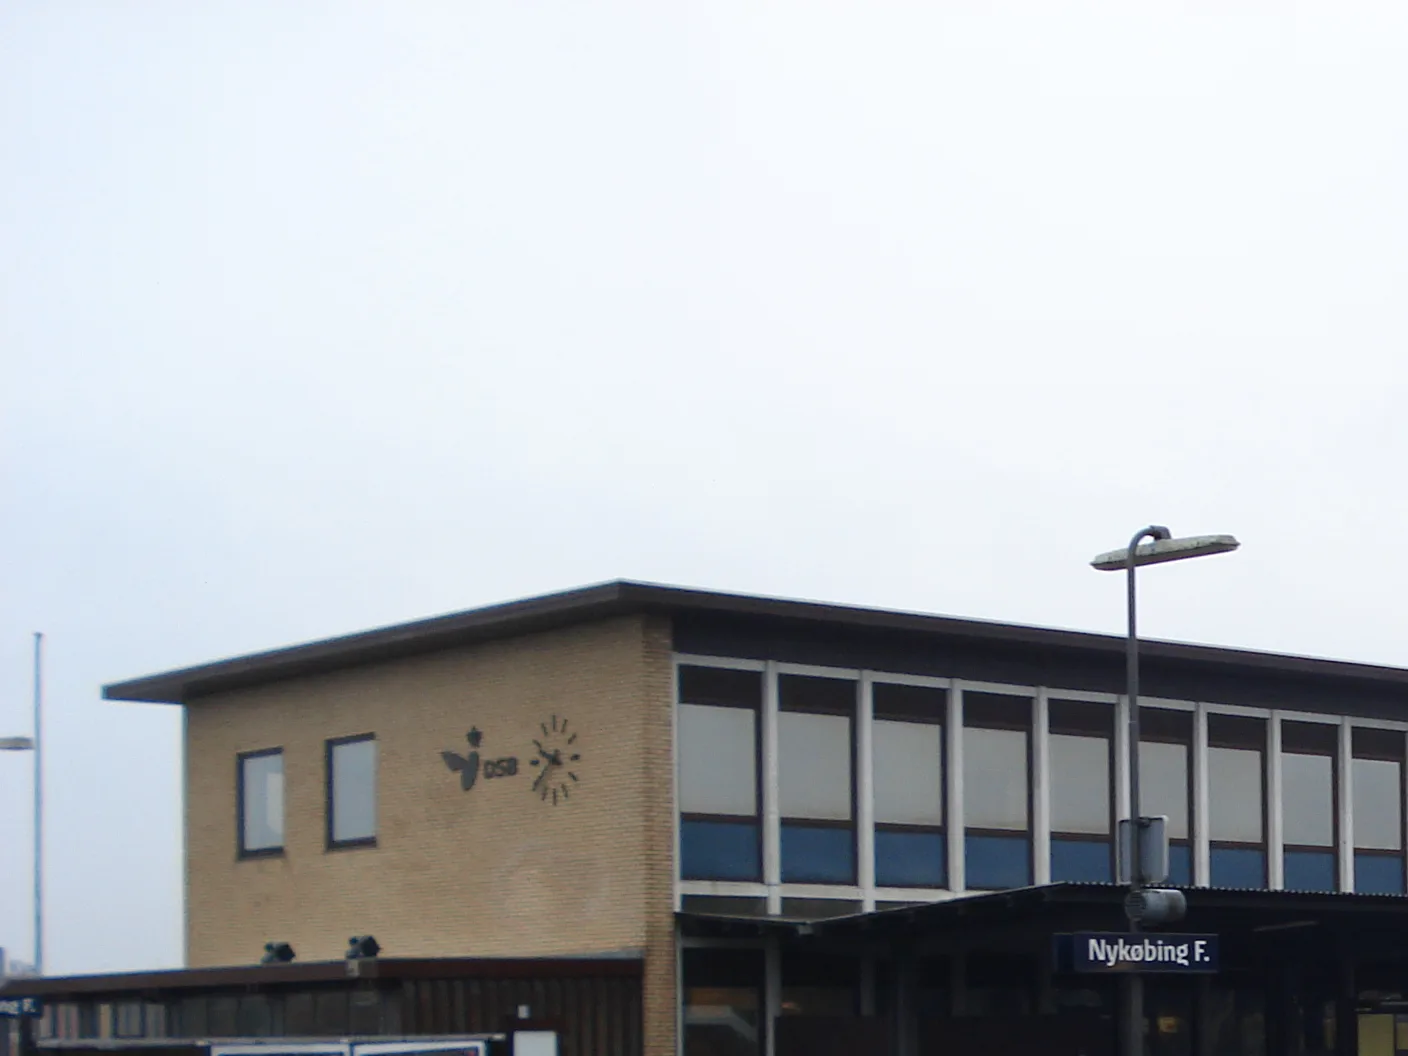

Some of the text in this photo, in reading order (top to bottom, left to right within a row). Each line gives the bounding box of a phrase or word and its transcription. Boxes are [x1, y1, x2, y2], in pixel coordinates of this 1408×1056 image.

[484, 757, 517, 779] DSB
[1088, 938, 1211, 966] Nykøbing F.
